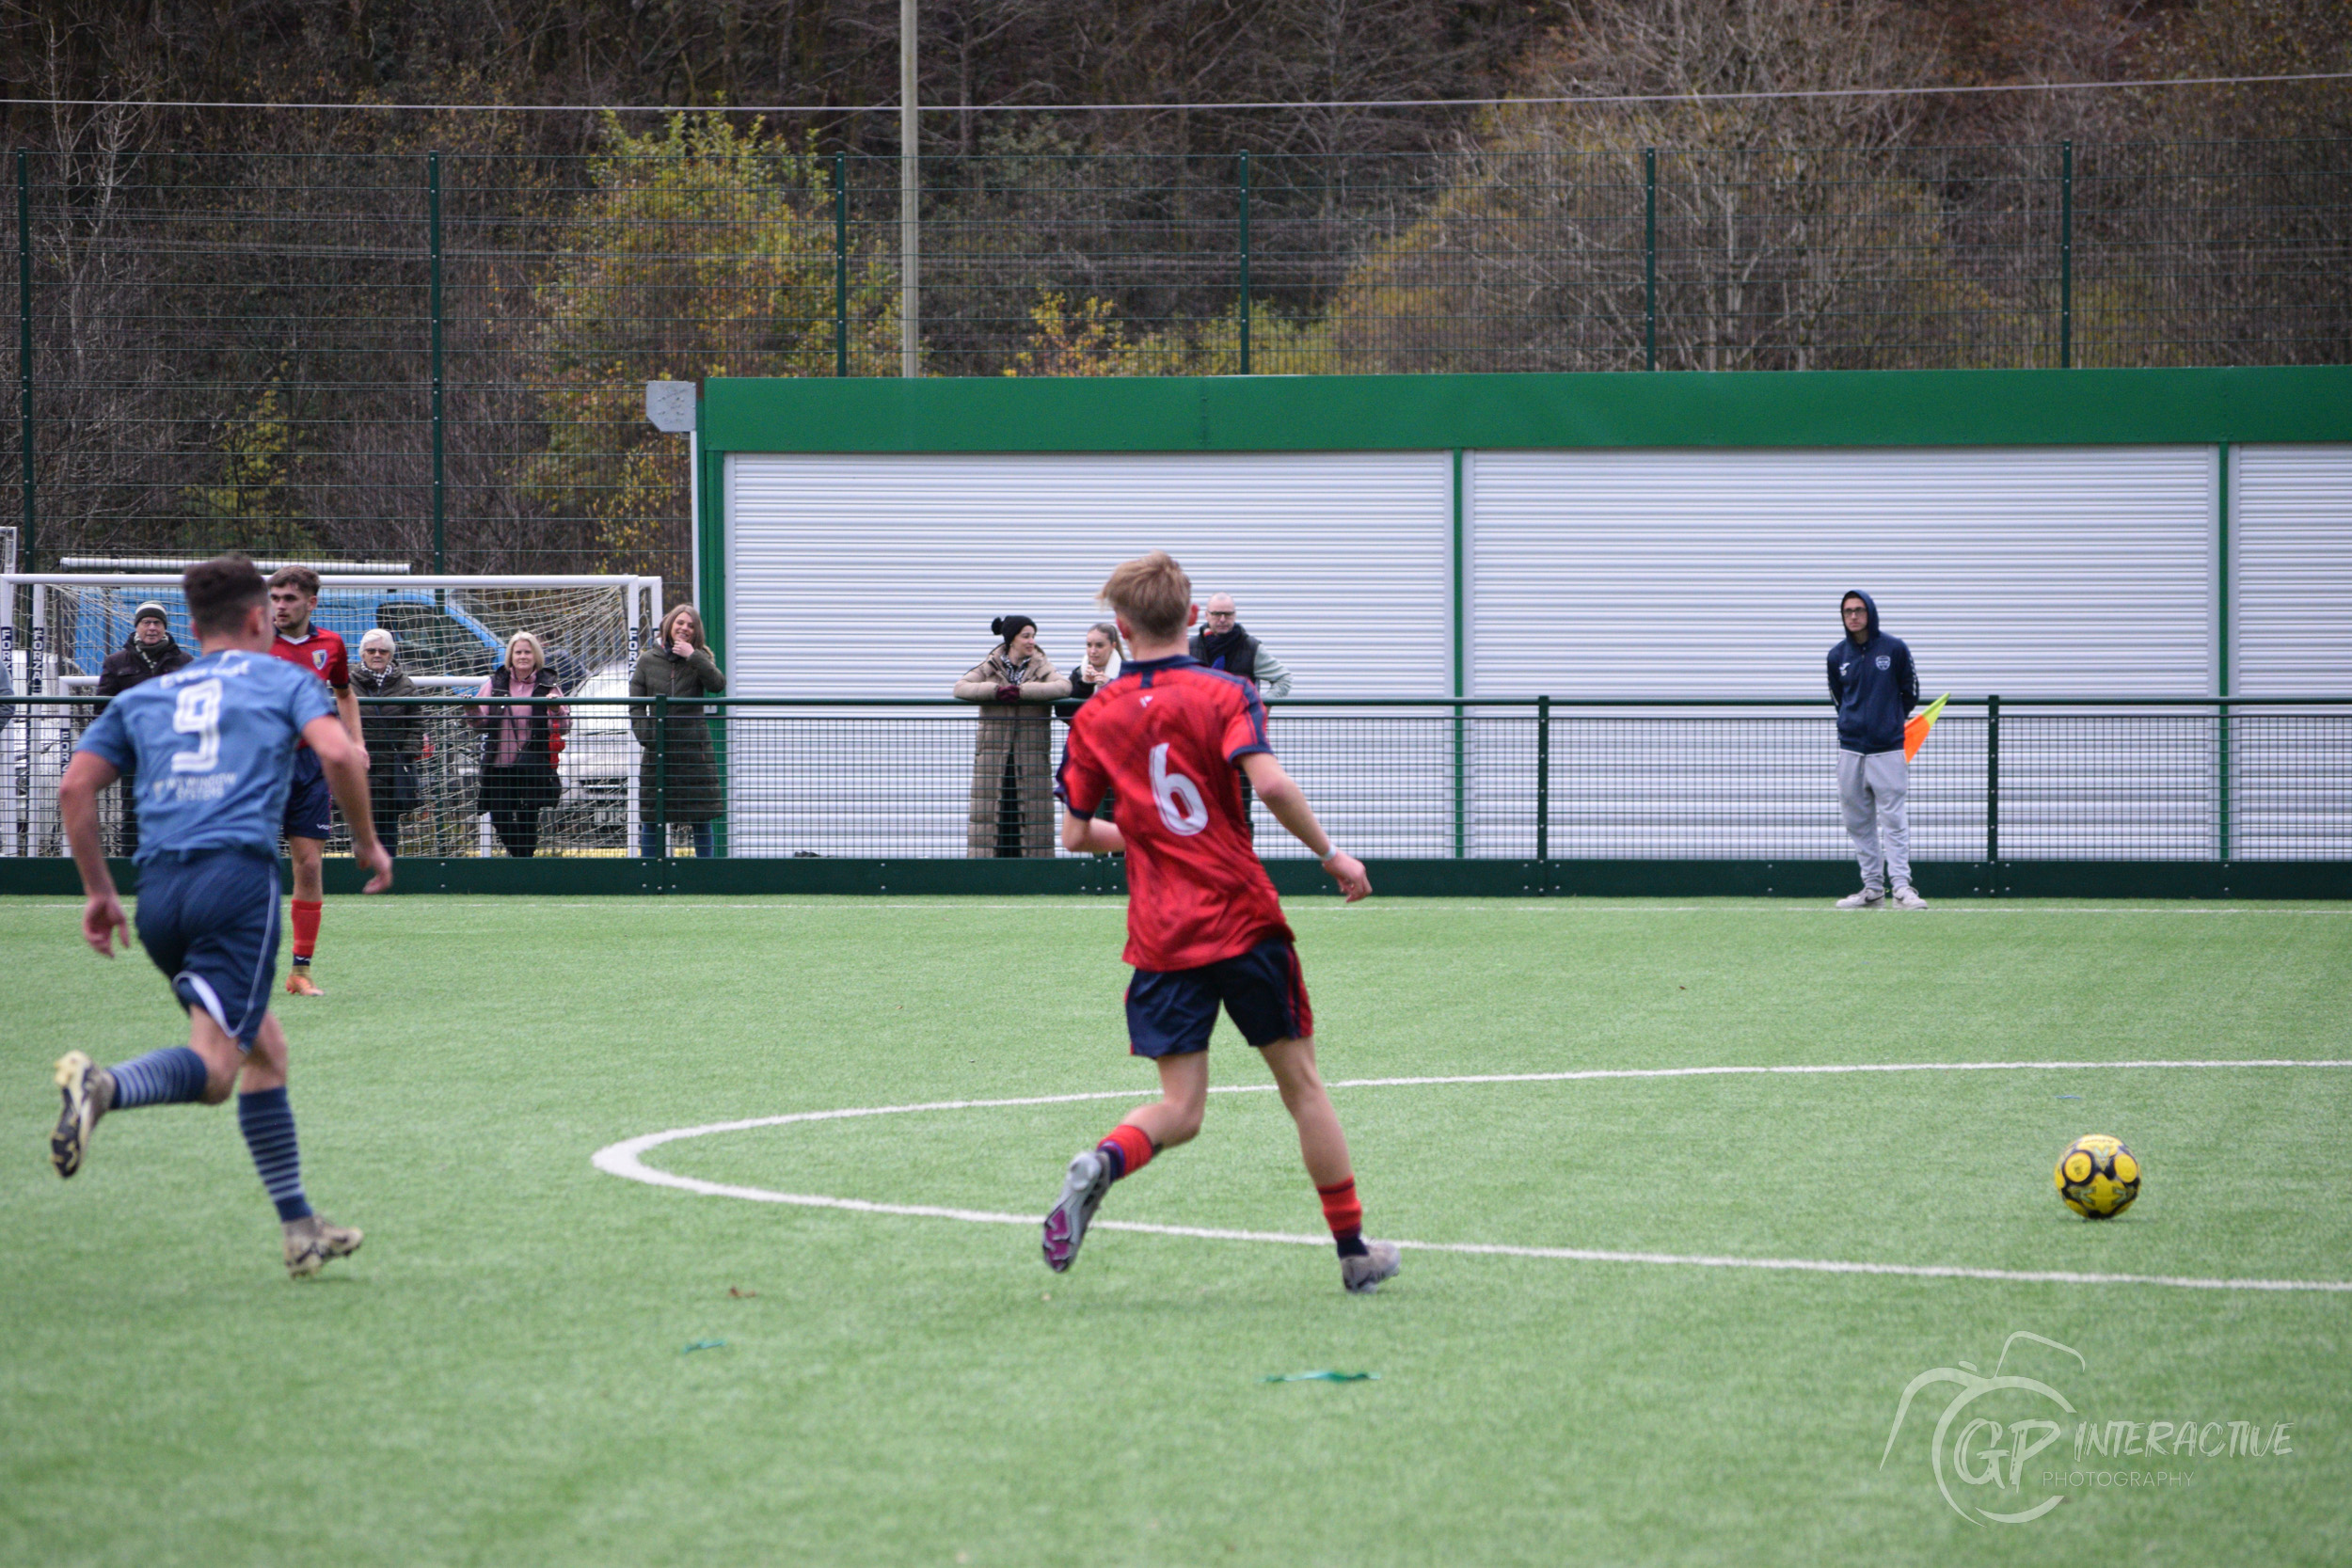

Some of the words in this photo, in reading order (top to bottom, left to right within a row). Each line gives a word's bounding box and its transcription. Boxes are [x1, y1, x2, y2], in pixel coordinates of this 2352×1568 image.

[33, 630, 43, 681] FORZA
[171, 677, 222, 772] 9
[1149, 742, 1209, 836] 6
